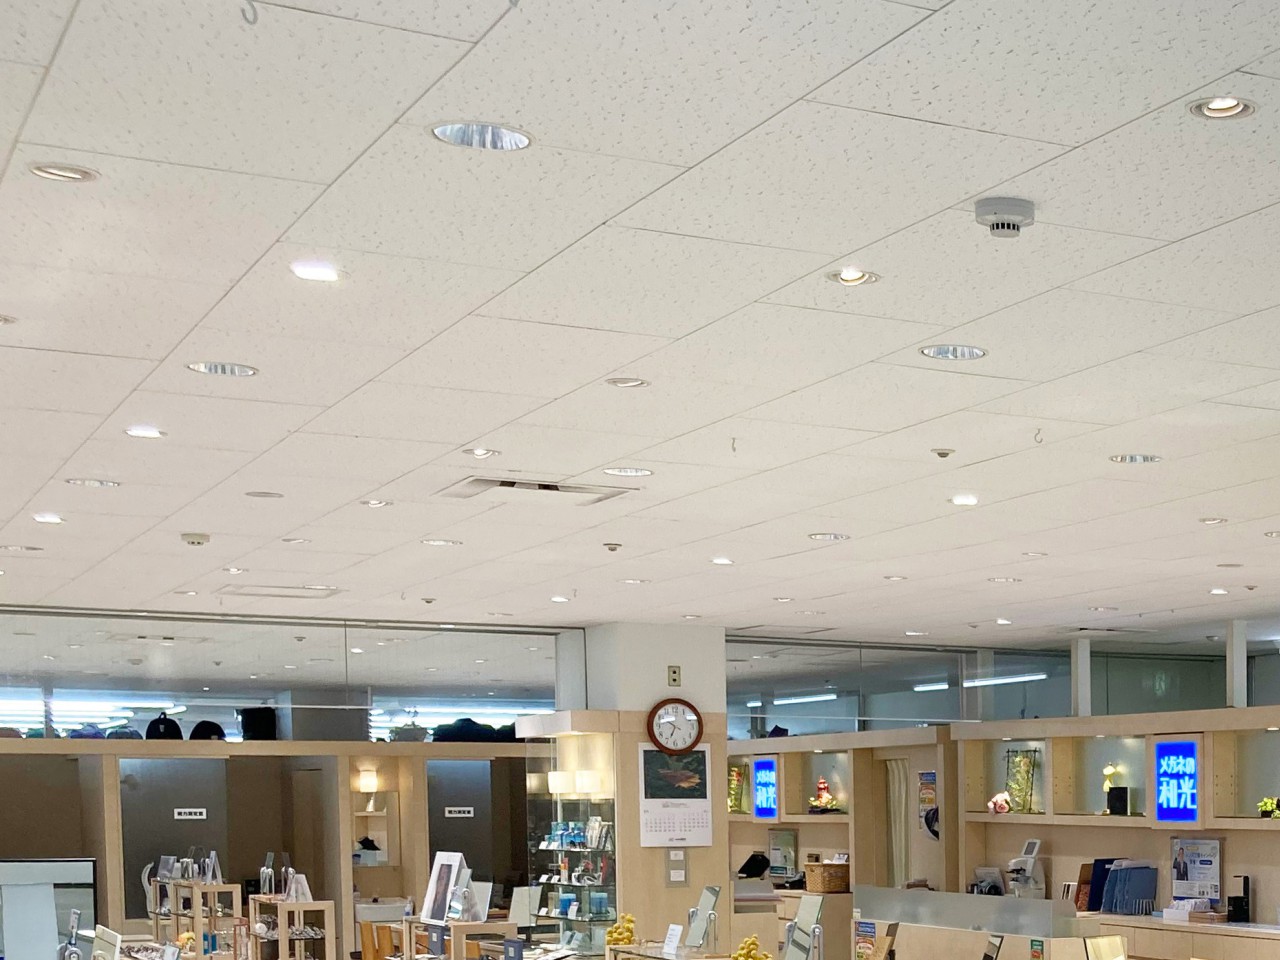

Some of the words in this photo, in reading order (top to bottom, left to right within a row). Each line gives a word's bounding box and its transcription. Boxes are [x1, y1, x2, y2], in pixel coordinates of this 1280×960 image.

[1160, 755, 1196, 775] メガネの
[1158, 776, 1197, 809] 和光
